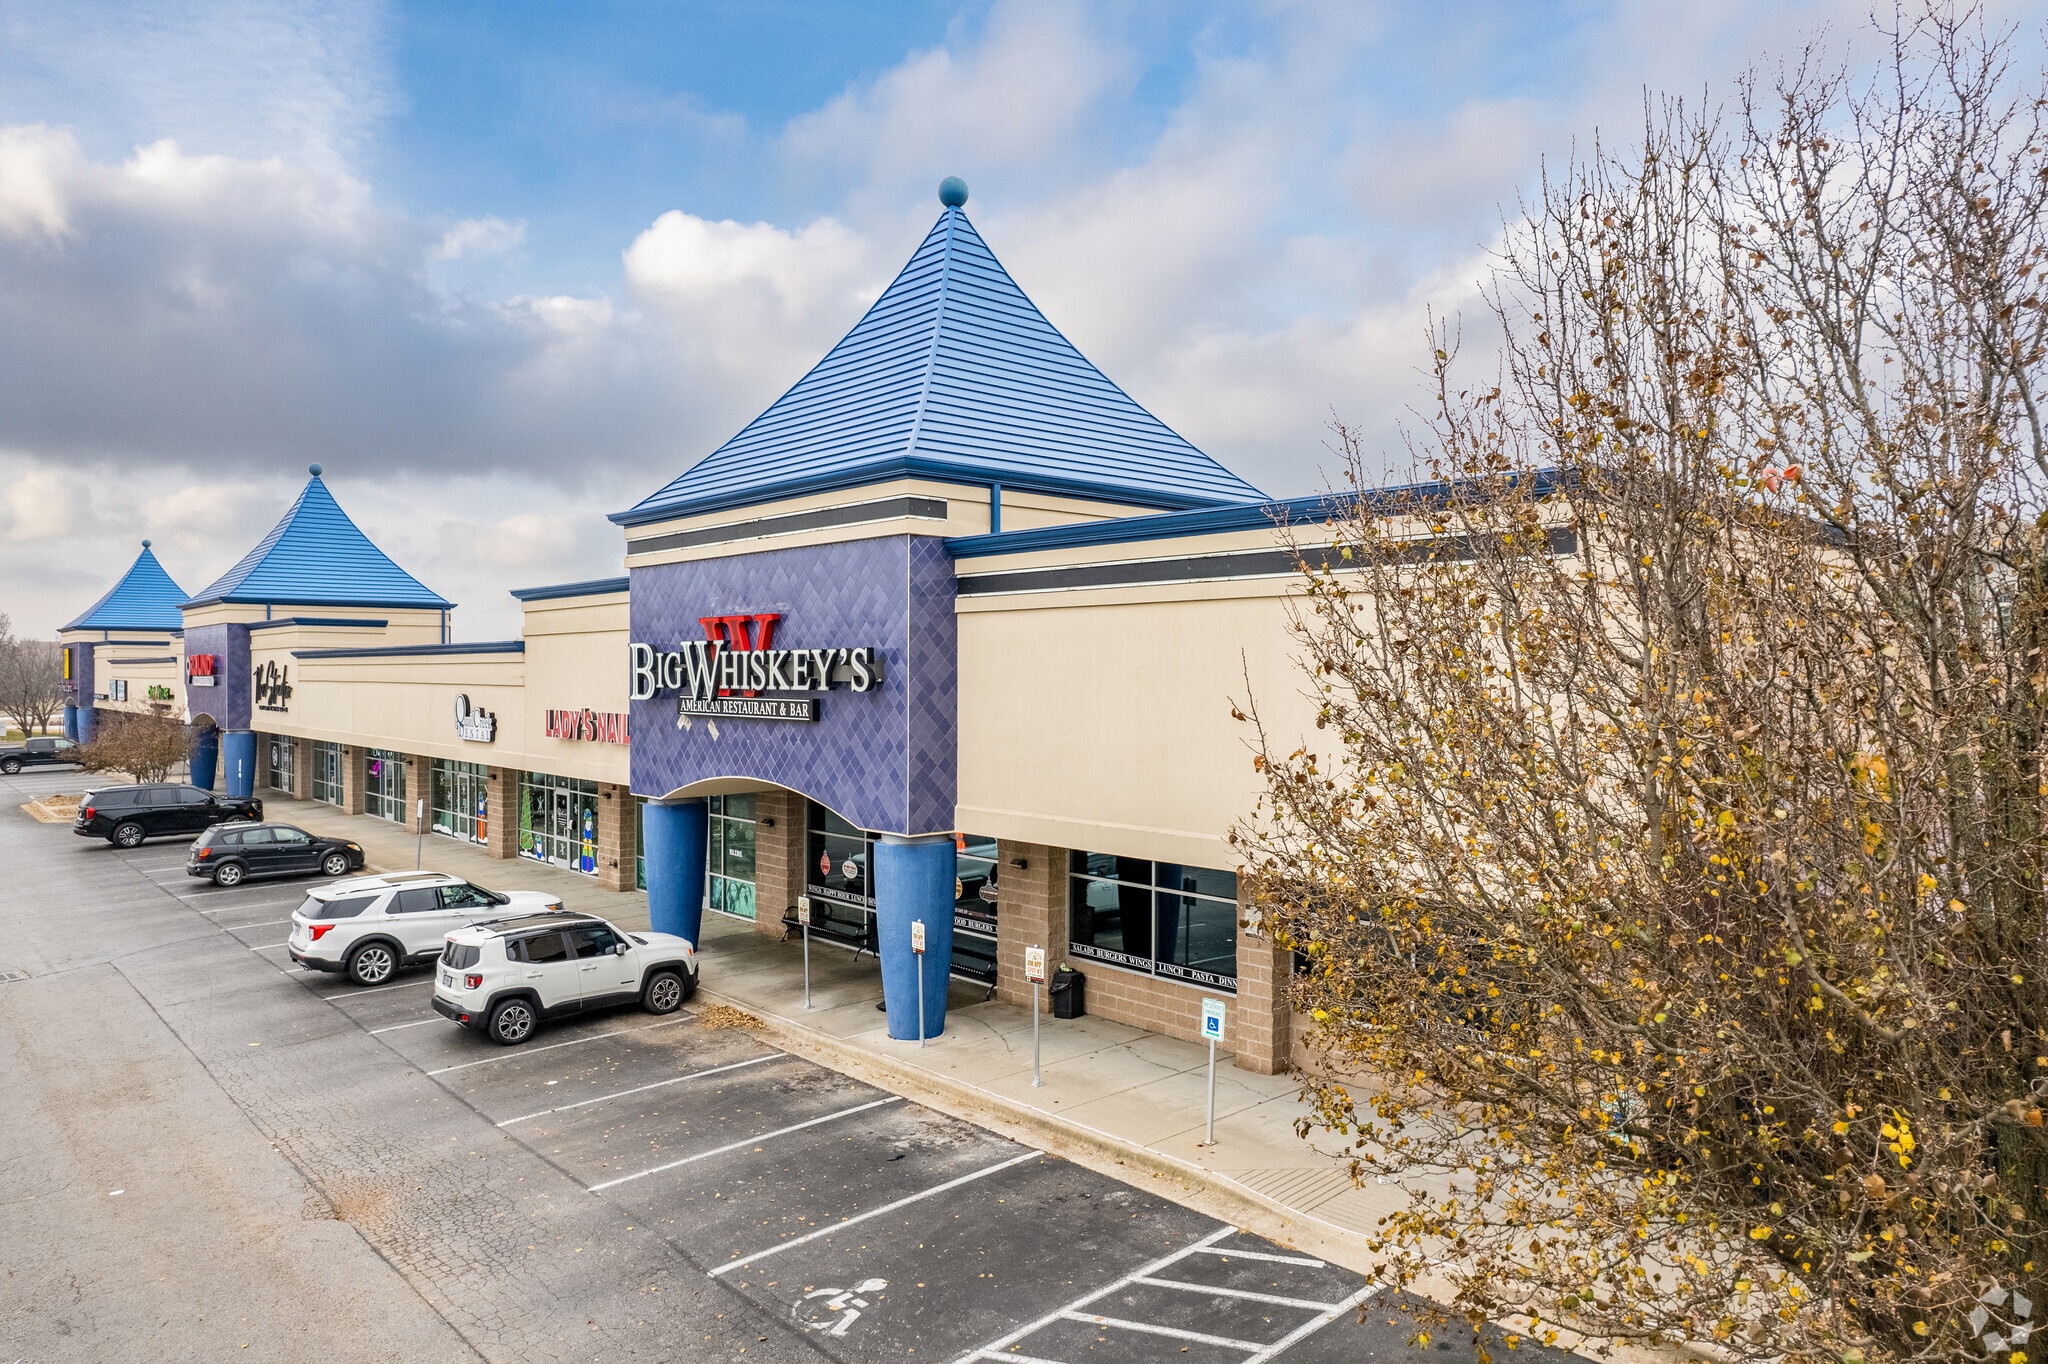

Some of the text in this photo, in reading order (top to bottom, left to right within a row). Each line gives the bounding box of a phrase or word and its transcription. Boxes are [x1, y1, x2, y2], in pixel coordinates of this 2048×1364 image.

[680, 699, 809, 717] AMERICAN RESTAURANT & BAR
[456, 722, 491, 741] DENTAL
[545, 708, 593, 742] LADY'S
[968, 920, 992, 932] BURGERS
[1072, 943, 1095, 956] SALADS
[1096, 949, 1127, 963] BURGERS
[1129, 957, 1152, 969] WINGS
[1158, 963, 1184, 976] LUNCH
[1191, 970, 1214, 983] PASTA
[1202, 1001, 1224, 1011] RESERVED
[1205, 1009, 1222, 1018] PARKING
